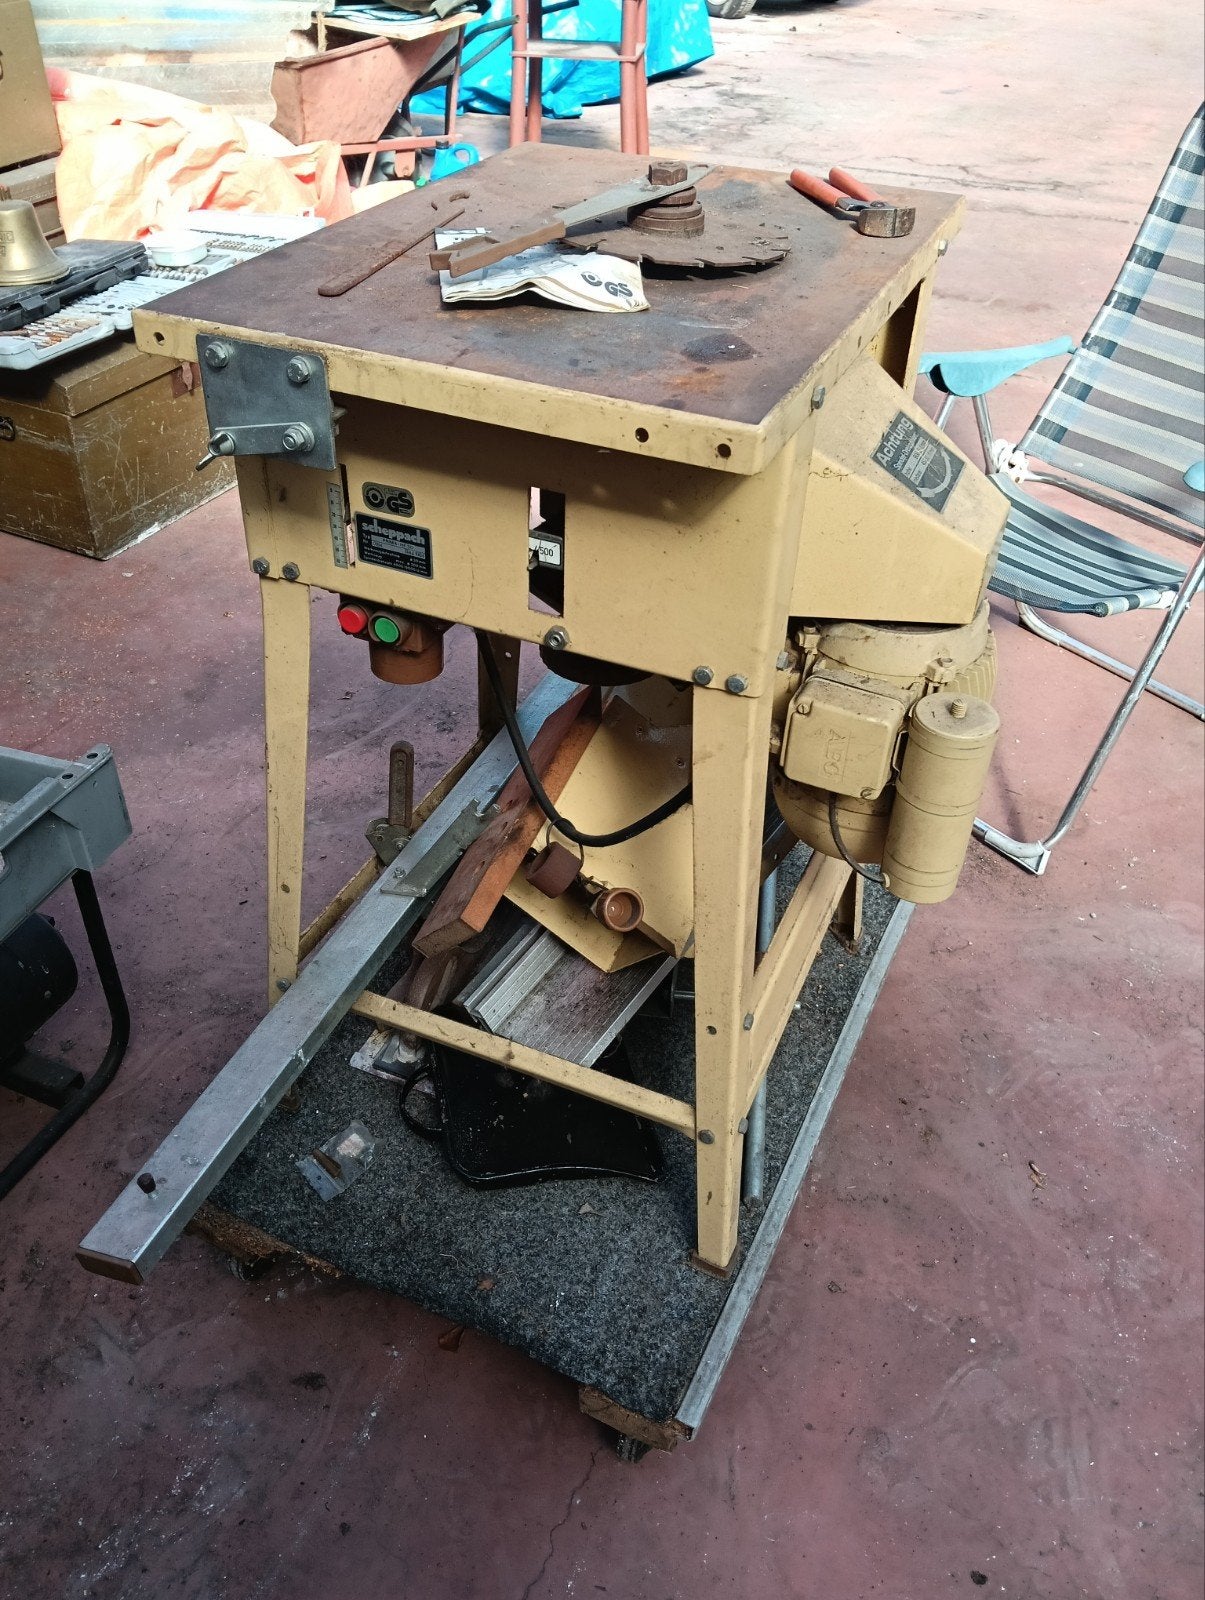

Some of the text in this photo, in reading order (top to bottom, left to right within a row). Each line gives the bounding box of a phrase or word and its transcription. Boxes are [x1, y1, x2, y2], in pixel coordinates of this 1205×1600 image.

[604, 281, 633, 297] GS
[876, 417, 914, 466] Achtung
[386, 492, 413, 513] GS
[361, 519, 425, 545] scheppach
